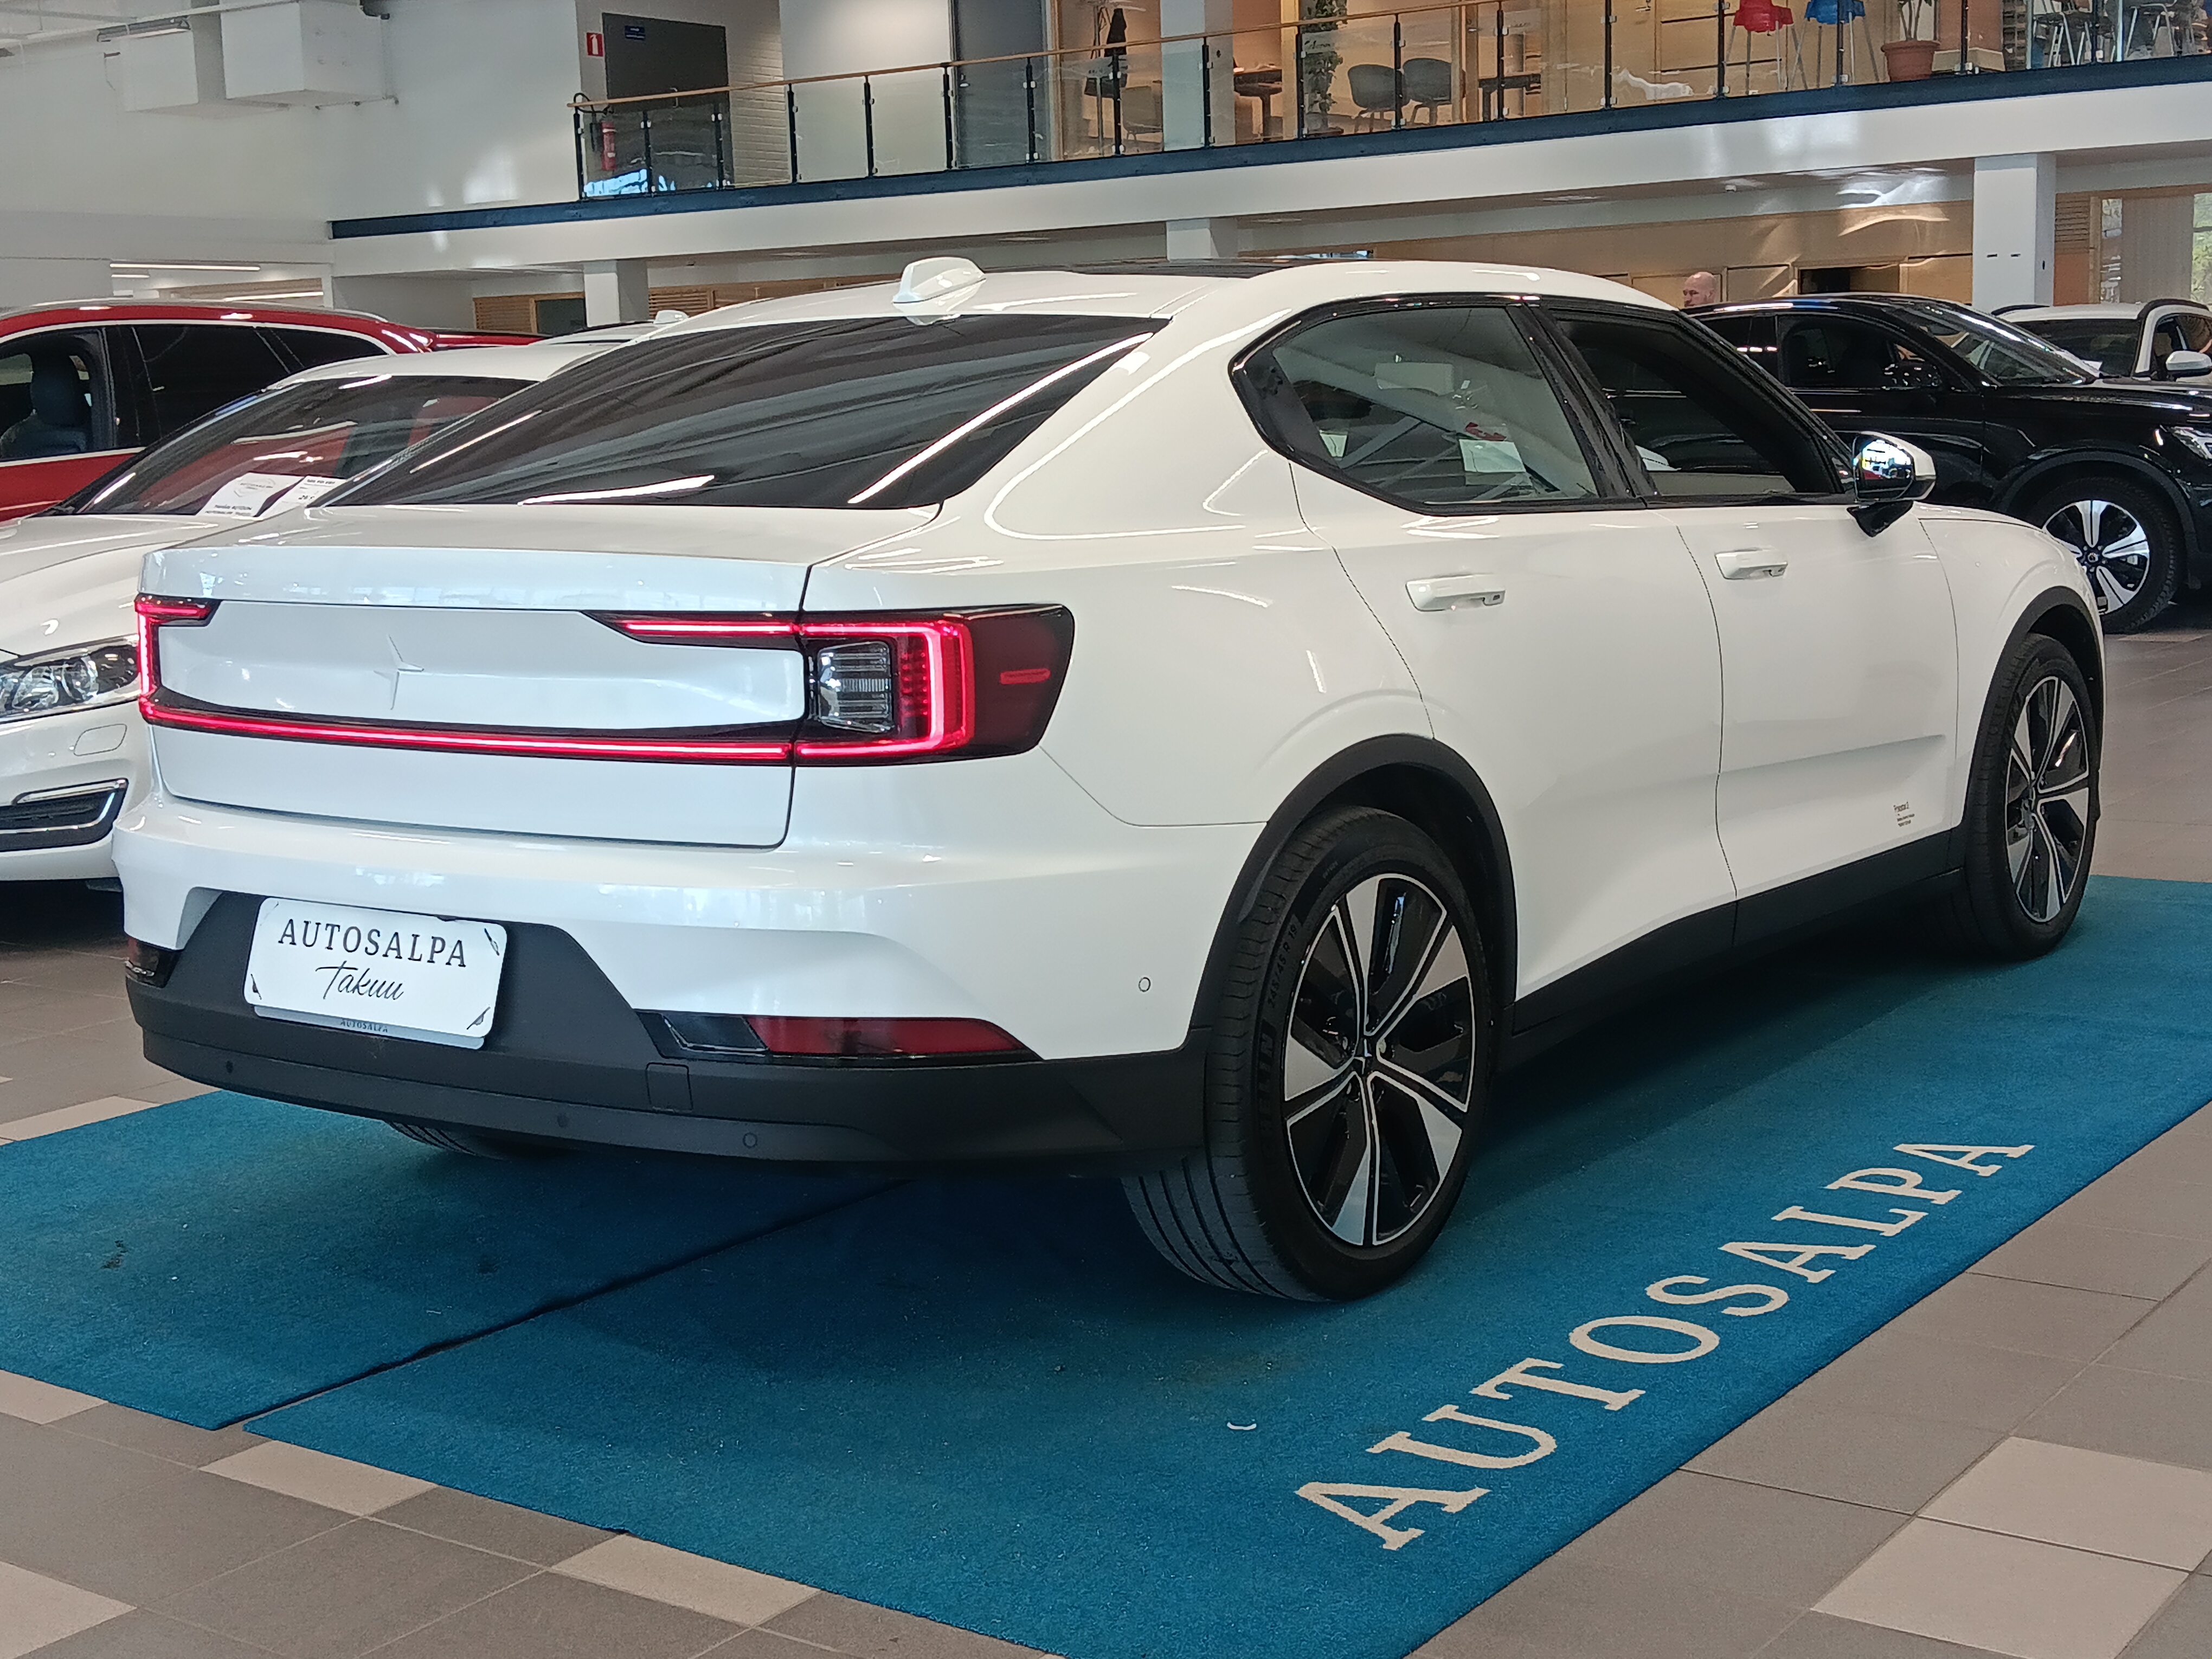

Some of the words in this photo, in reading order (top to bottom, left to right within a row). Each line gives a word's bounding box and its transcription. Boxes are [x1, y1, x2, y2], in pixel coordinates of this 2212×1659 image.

[278, 918, 467, 968] AUTOSALPA
[315, 960, 404, 1000] Takuu
[340, 1019, 388, 1033] AUTOSALPA
[1294, 1142, 2035, 1549] AUTOSALPA
